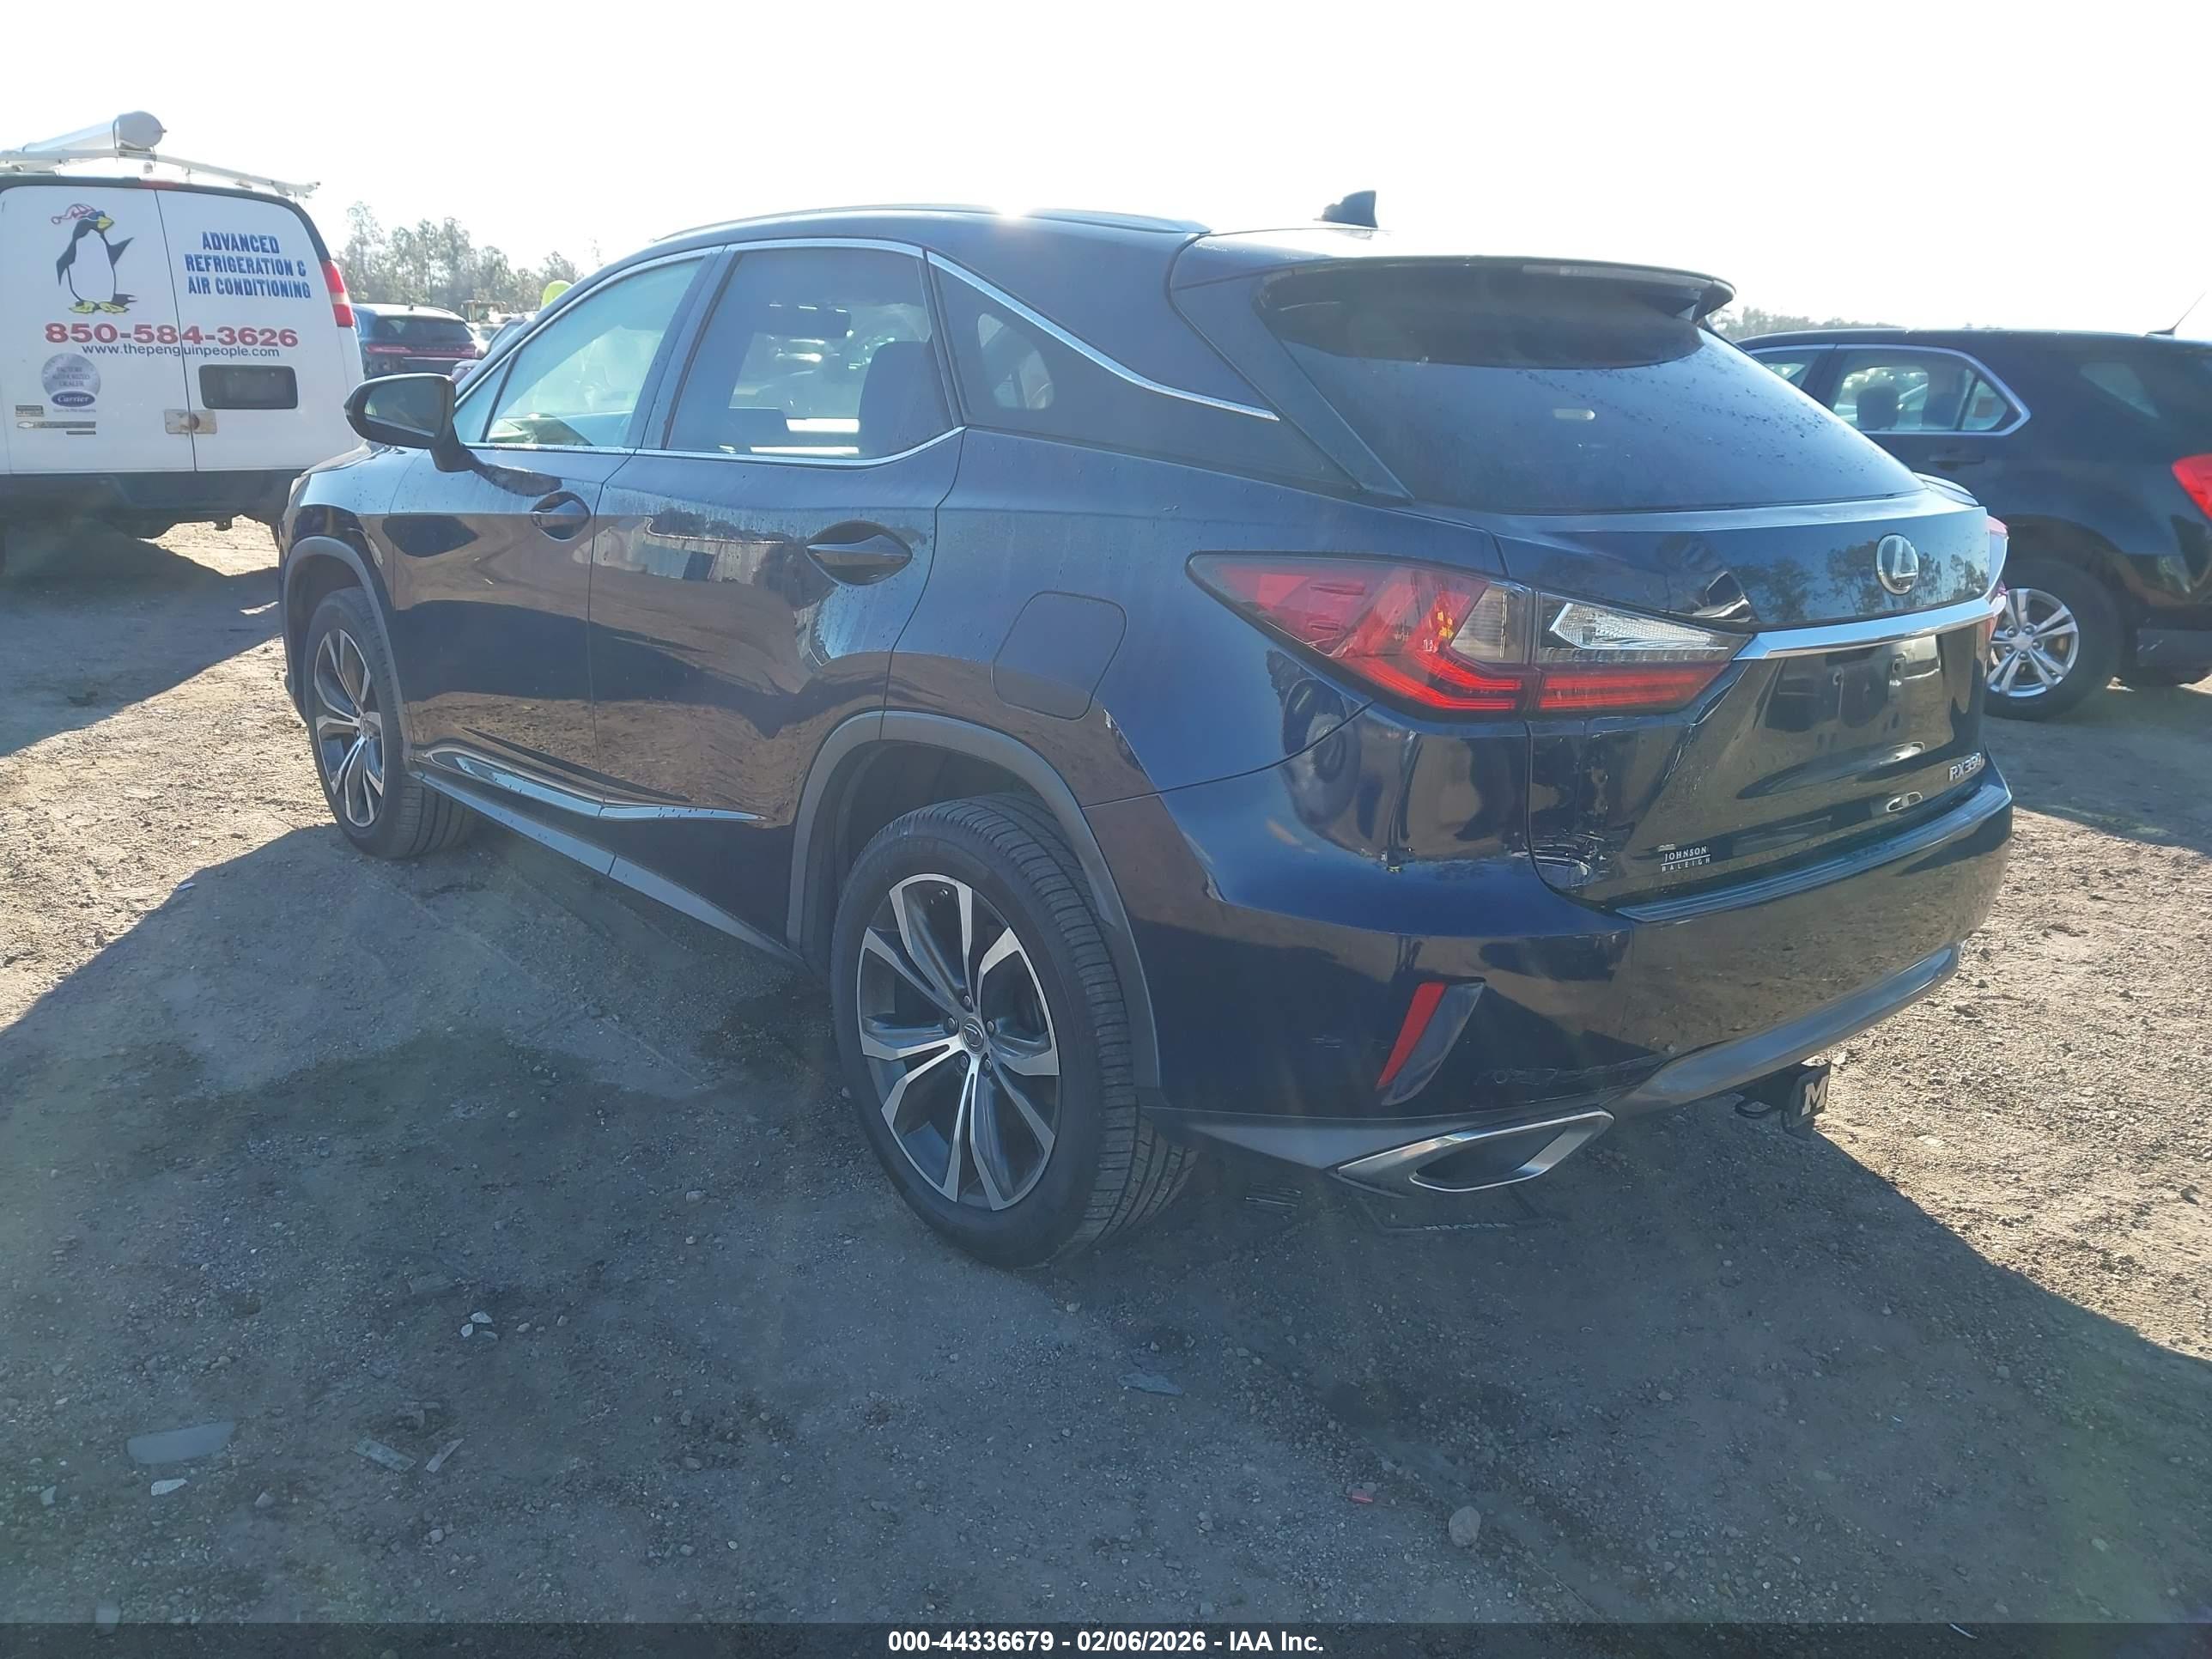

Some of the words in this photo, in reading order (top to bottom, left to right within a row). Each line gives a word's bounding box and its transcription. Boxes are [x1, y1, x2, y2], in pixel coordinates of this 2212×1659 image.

[202, 231, 280, 254] ADVANCED
[185, 253, 294, 276] REFRIGERATION
[296, 260, 307, 276] &
[188, 276, 211, 295] AIR
[216, 276, 312, 299] CONDITIONING
[45, 322, 299, 348] 850-584-3626
[82, 343, 280, 358] www.thepenguinpeople.com
[57, 395, 89, 404] Carrier
[1664, 845, 1708, 863] JOHNSON
[1662, 857, 1711, 872] RALEIGH
